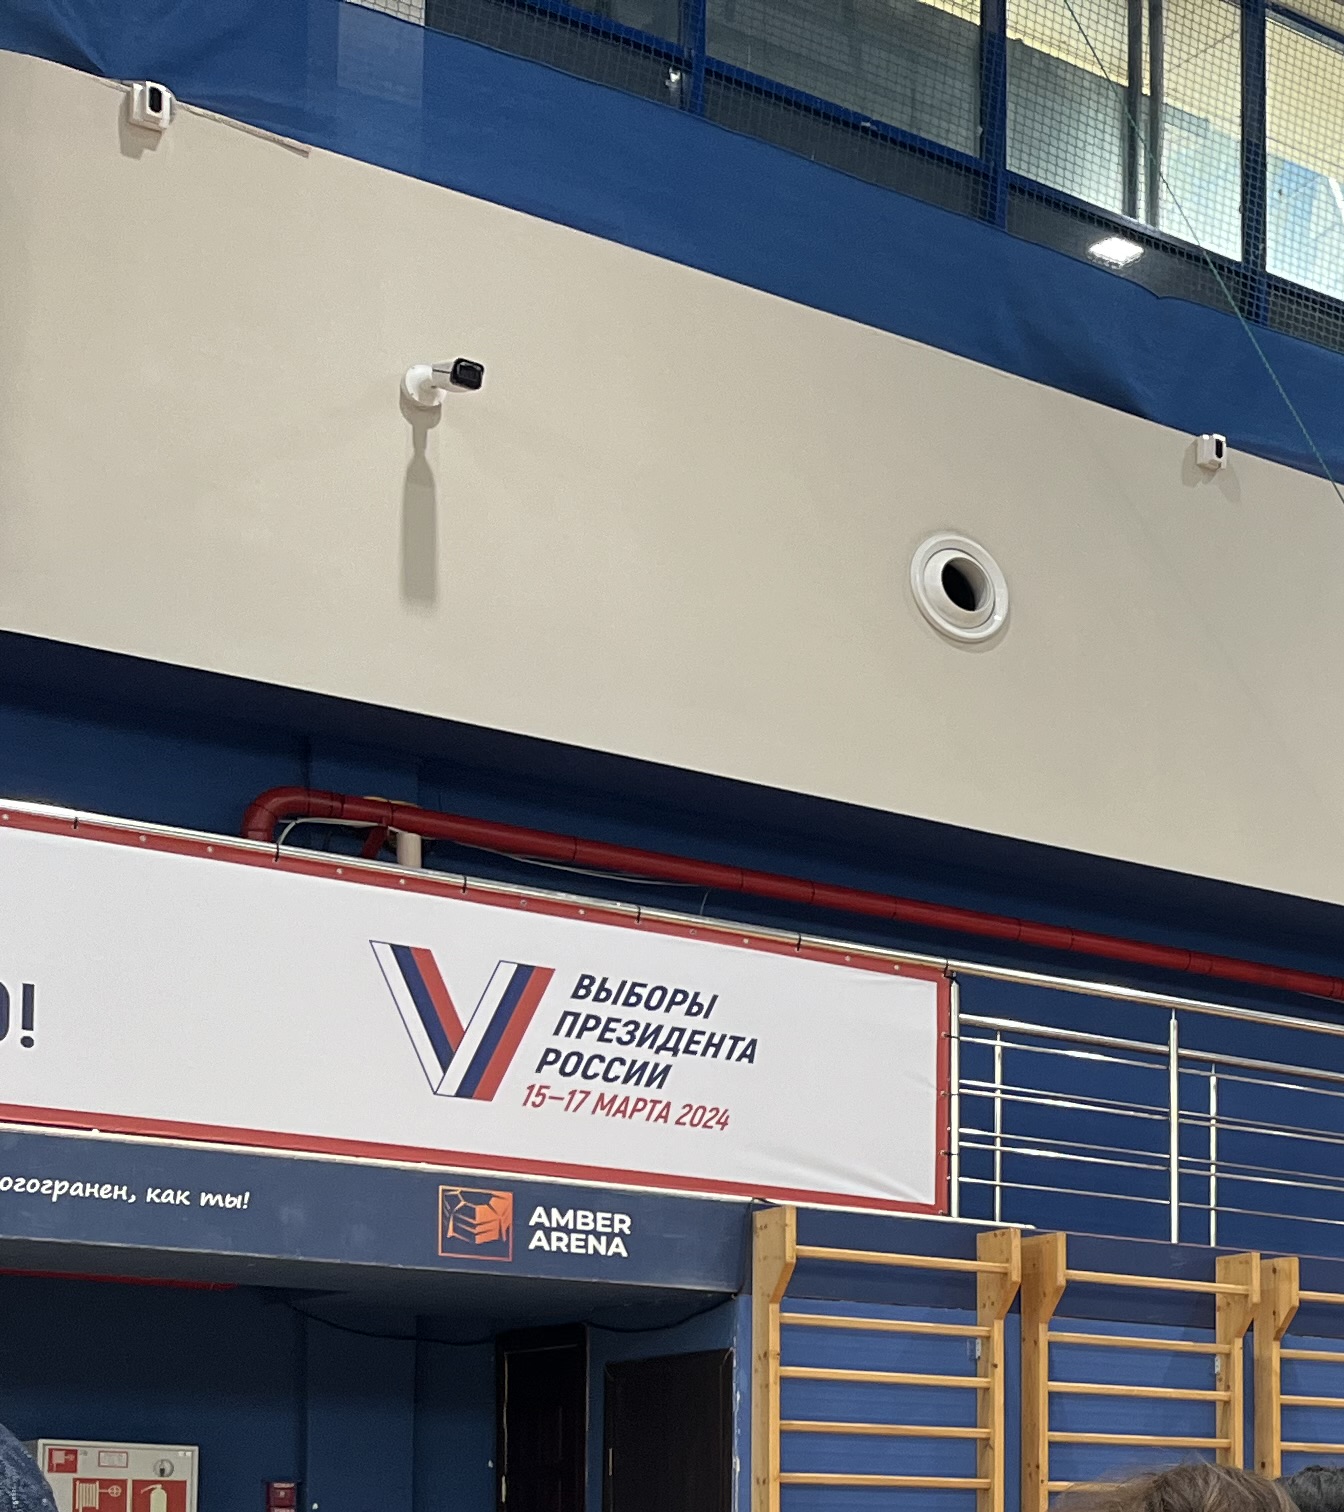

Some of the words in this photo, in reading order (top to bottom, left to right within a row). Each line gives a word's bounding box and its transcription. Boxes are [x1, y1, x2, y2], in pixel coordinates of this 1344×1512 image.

[570, 973, 719, 1019] ВЫБОРЫ
[552, 1010, 758, 1064] ПРЕЗИДЕНТА
[535, 1047, 673, 1090] РОССИИ
[591, 1092, 672, 1124] МАРТА
[674, 1103, 731, 1131] 2024
[146, 1187, 191, 1205] как
[199, 1191, 251, 1209] ты!
[528, 1206, 632, 1235] AMBER
[528, 1230, 629, 1258] ARENA
